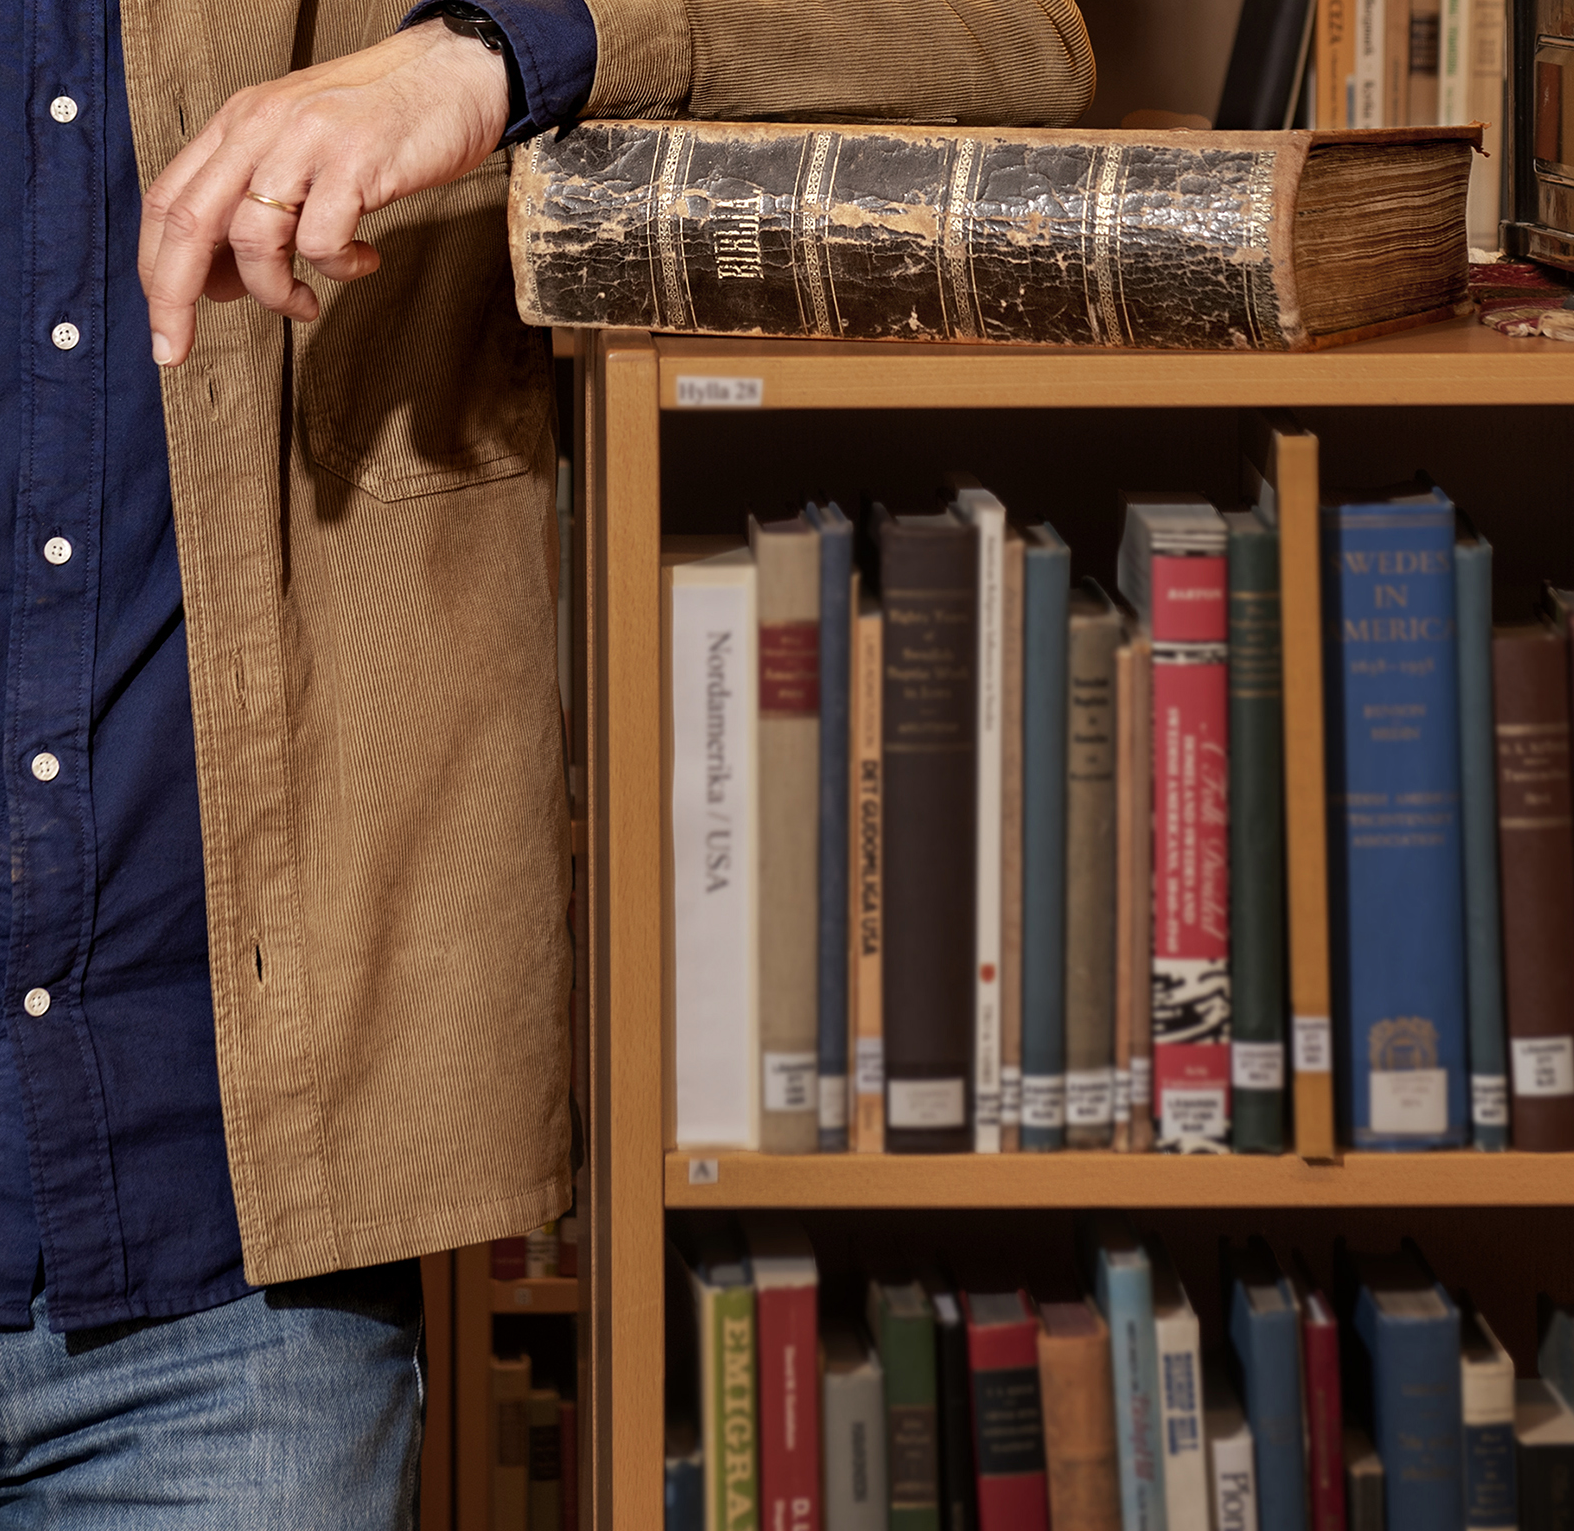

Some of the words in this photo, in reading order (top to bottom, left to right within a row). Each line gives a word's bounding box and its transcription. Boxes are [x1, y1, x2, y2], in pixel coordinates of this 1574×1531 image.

[714, 189, 764, 280] BIBLIA
[678, 380, 730, 404] Hylla
[733, 380, 759, 399] 28
[1330, 550, 1451, 575] SWEDES
[1374, 584, 1408, 609] IN
[1325, 616, 1459, 642] AMERICA
[707, 630, 733, 805] Nordamerika
[861, 759, 879, 795] DET
[707, 829, 733, 895] USA
[861, 800, 879, 913] GUDOMLIGA
[1182, 827, 1195, 887] SWEDES
[1182, 891, 1195, 925] AND
[861, 917, 879, 957] USA
[693, 1159, 712, 1179] A
[723, 1316, 752, 1531] EMIGRA
[791, 1498, 811, 1517] D.
